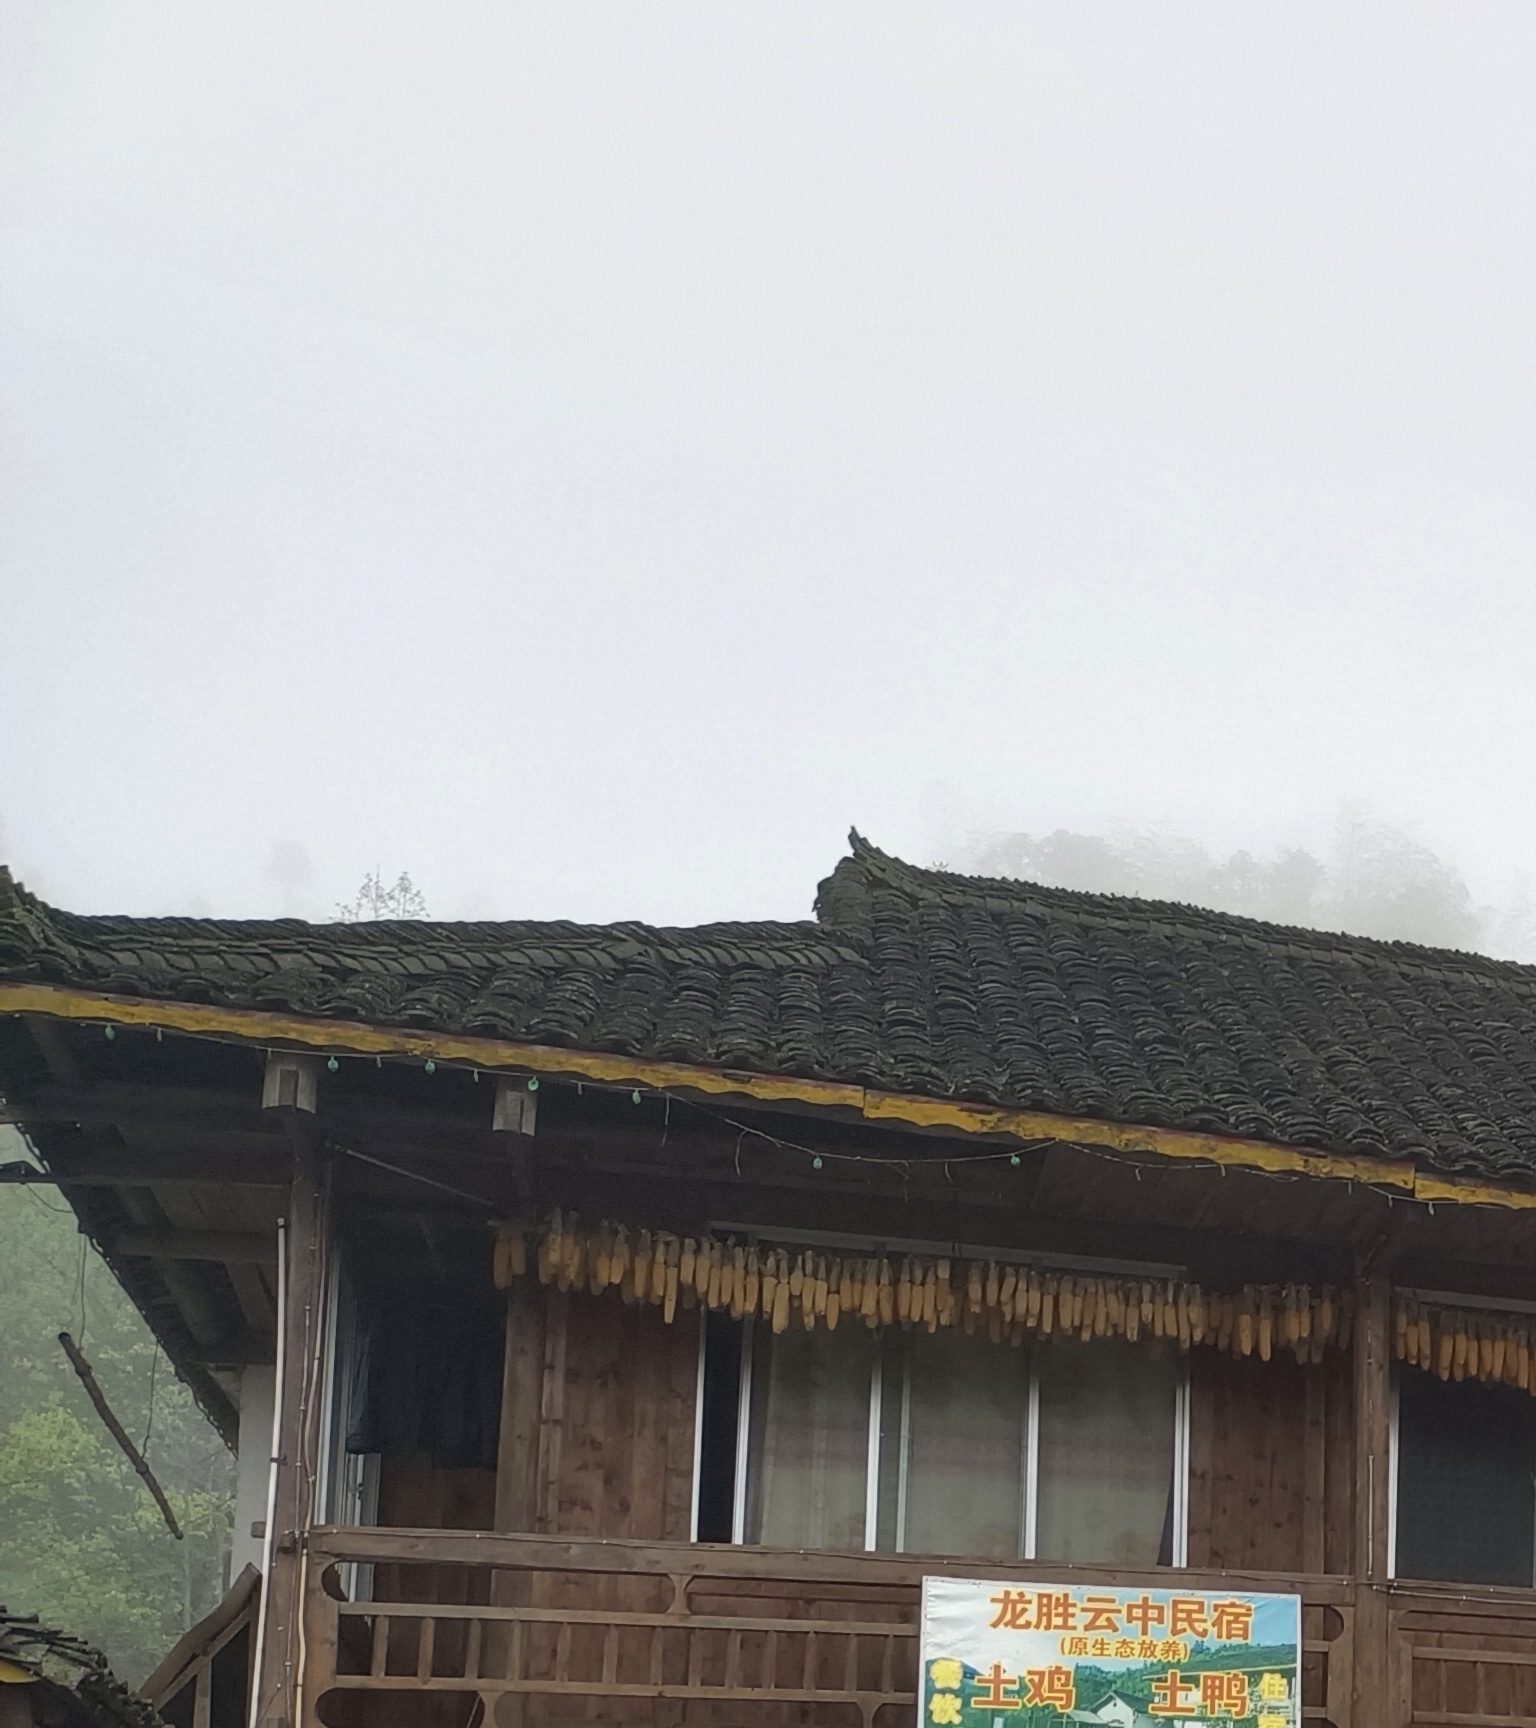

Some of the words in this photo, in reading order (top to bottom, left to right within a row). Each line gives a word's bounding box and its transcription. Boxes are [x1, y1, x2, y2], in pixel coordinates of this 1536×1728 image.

[989, 1589, 1254, 1641] 龙胜云中民宿
[1059, 1637, 1190, 1661] (原生态放养)
[928, 1657, 963, 1726] 餐饮
[971, 1662, 1077, 1711] 土鸡
[1148, 1670, 1250, 1719] 土鸭
